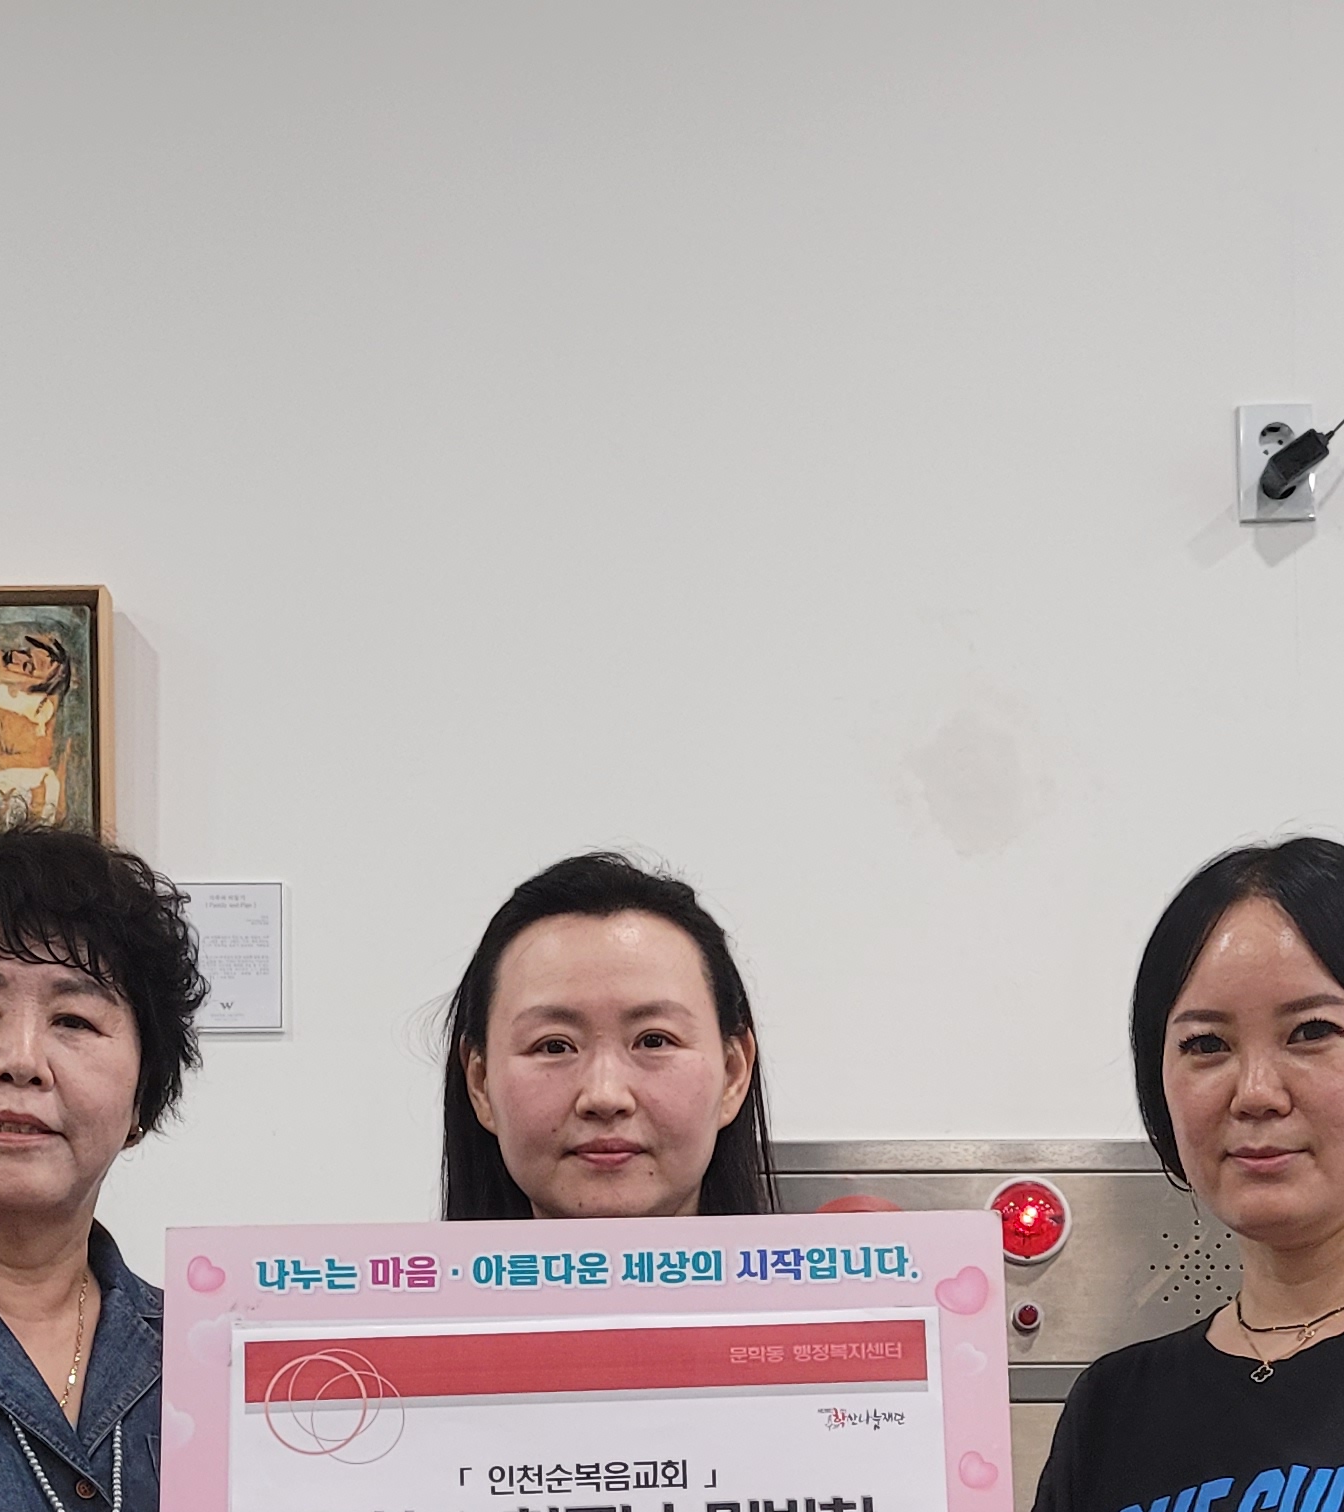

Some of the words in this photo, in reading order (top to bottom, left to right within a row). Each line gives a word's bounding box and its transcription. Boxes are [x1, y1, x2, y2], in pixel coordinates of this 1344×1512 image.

[256, 1257, 357, 1290] 나누는
[369, 1256, 438, 1289] 마음
[472, 1253, 609, 1286] 아름다운
[621, 1250, 723, 1284] 세상의
[736, 1246, 919, 1281] 시작입니다.
[729, 1345, 784, 1364] 문학동
[793, 1341, 903, 1361] 행정복지센터
[488, 1459, 689, 1496] 인천순복음교회
